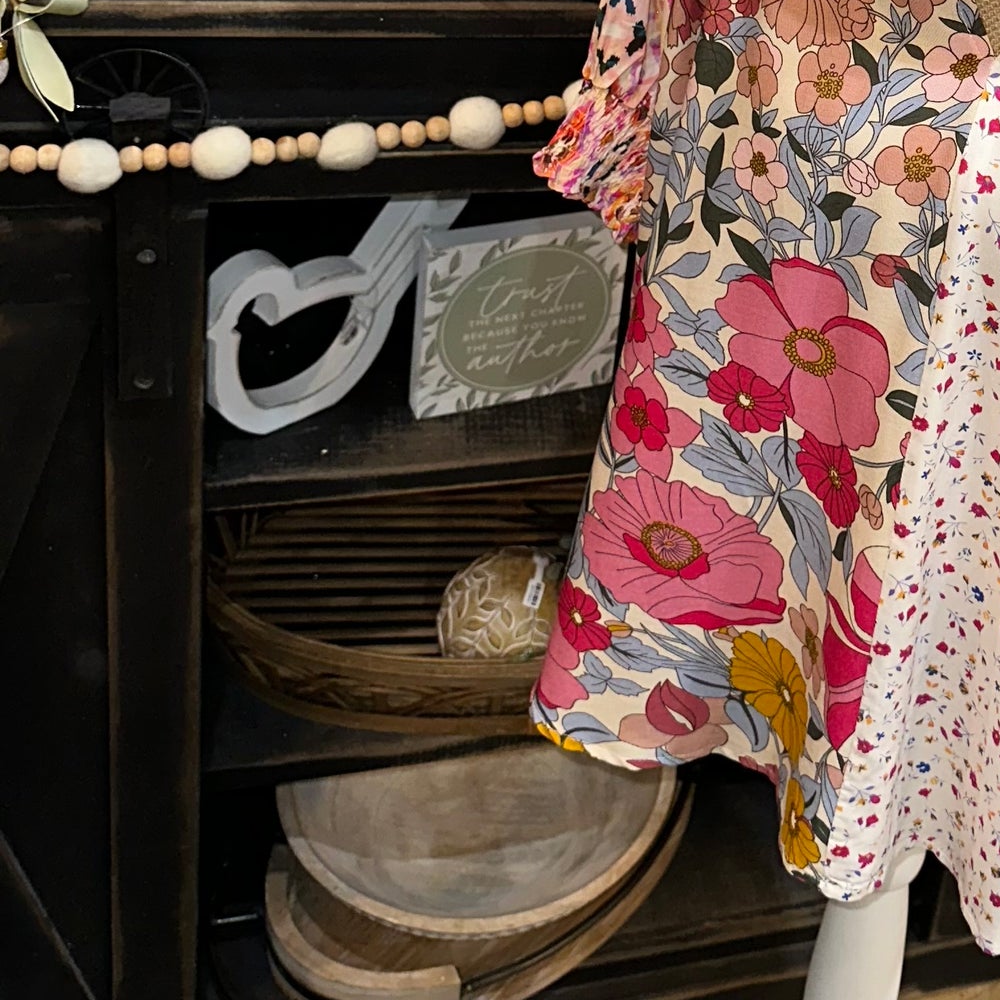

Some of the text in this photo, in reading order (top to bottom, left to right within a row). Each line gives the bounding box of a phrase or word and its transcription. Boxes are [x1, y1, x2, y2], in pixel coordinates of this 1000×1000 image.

[478, 266, 588, 318] trust
[462, 314, 587, 342] BECAUSE YOU KNOW
[469, 302, 584, 328] THE NEXT CHAPTER
[467, 344, 488, 354] THE
[467, 330, 580, 374] author
